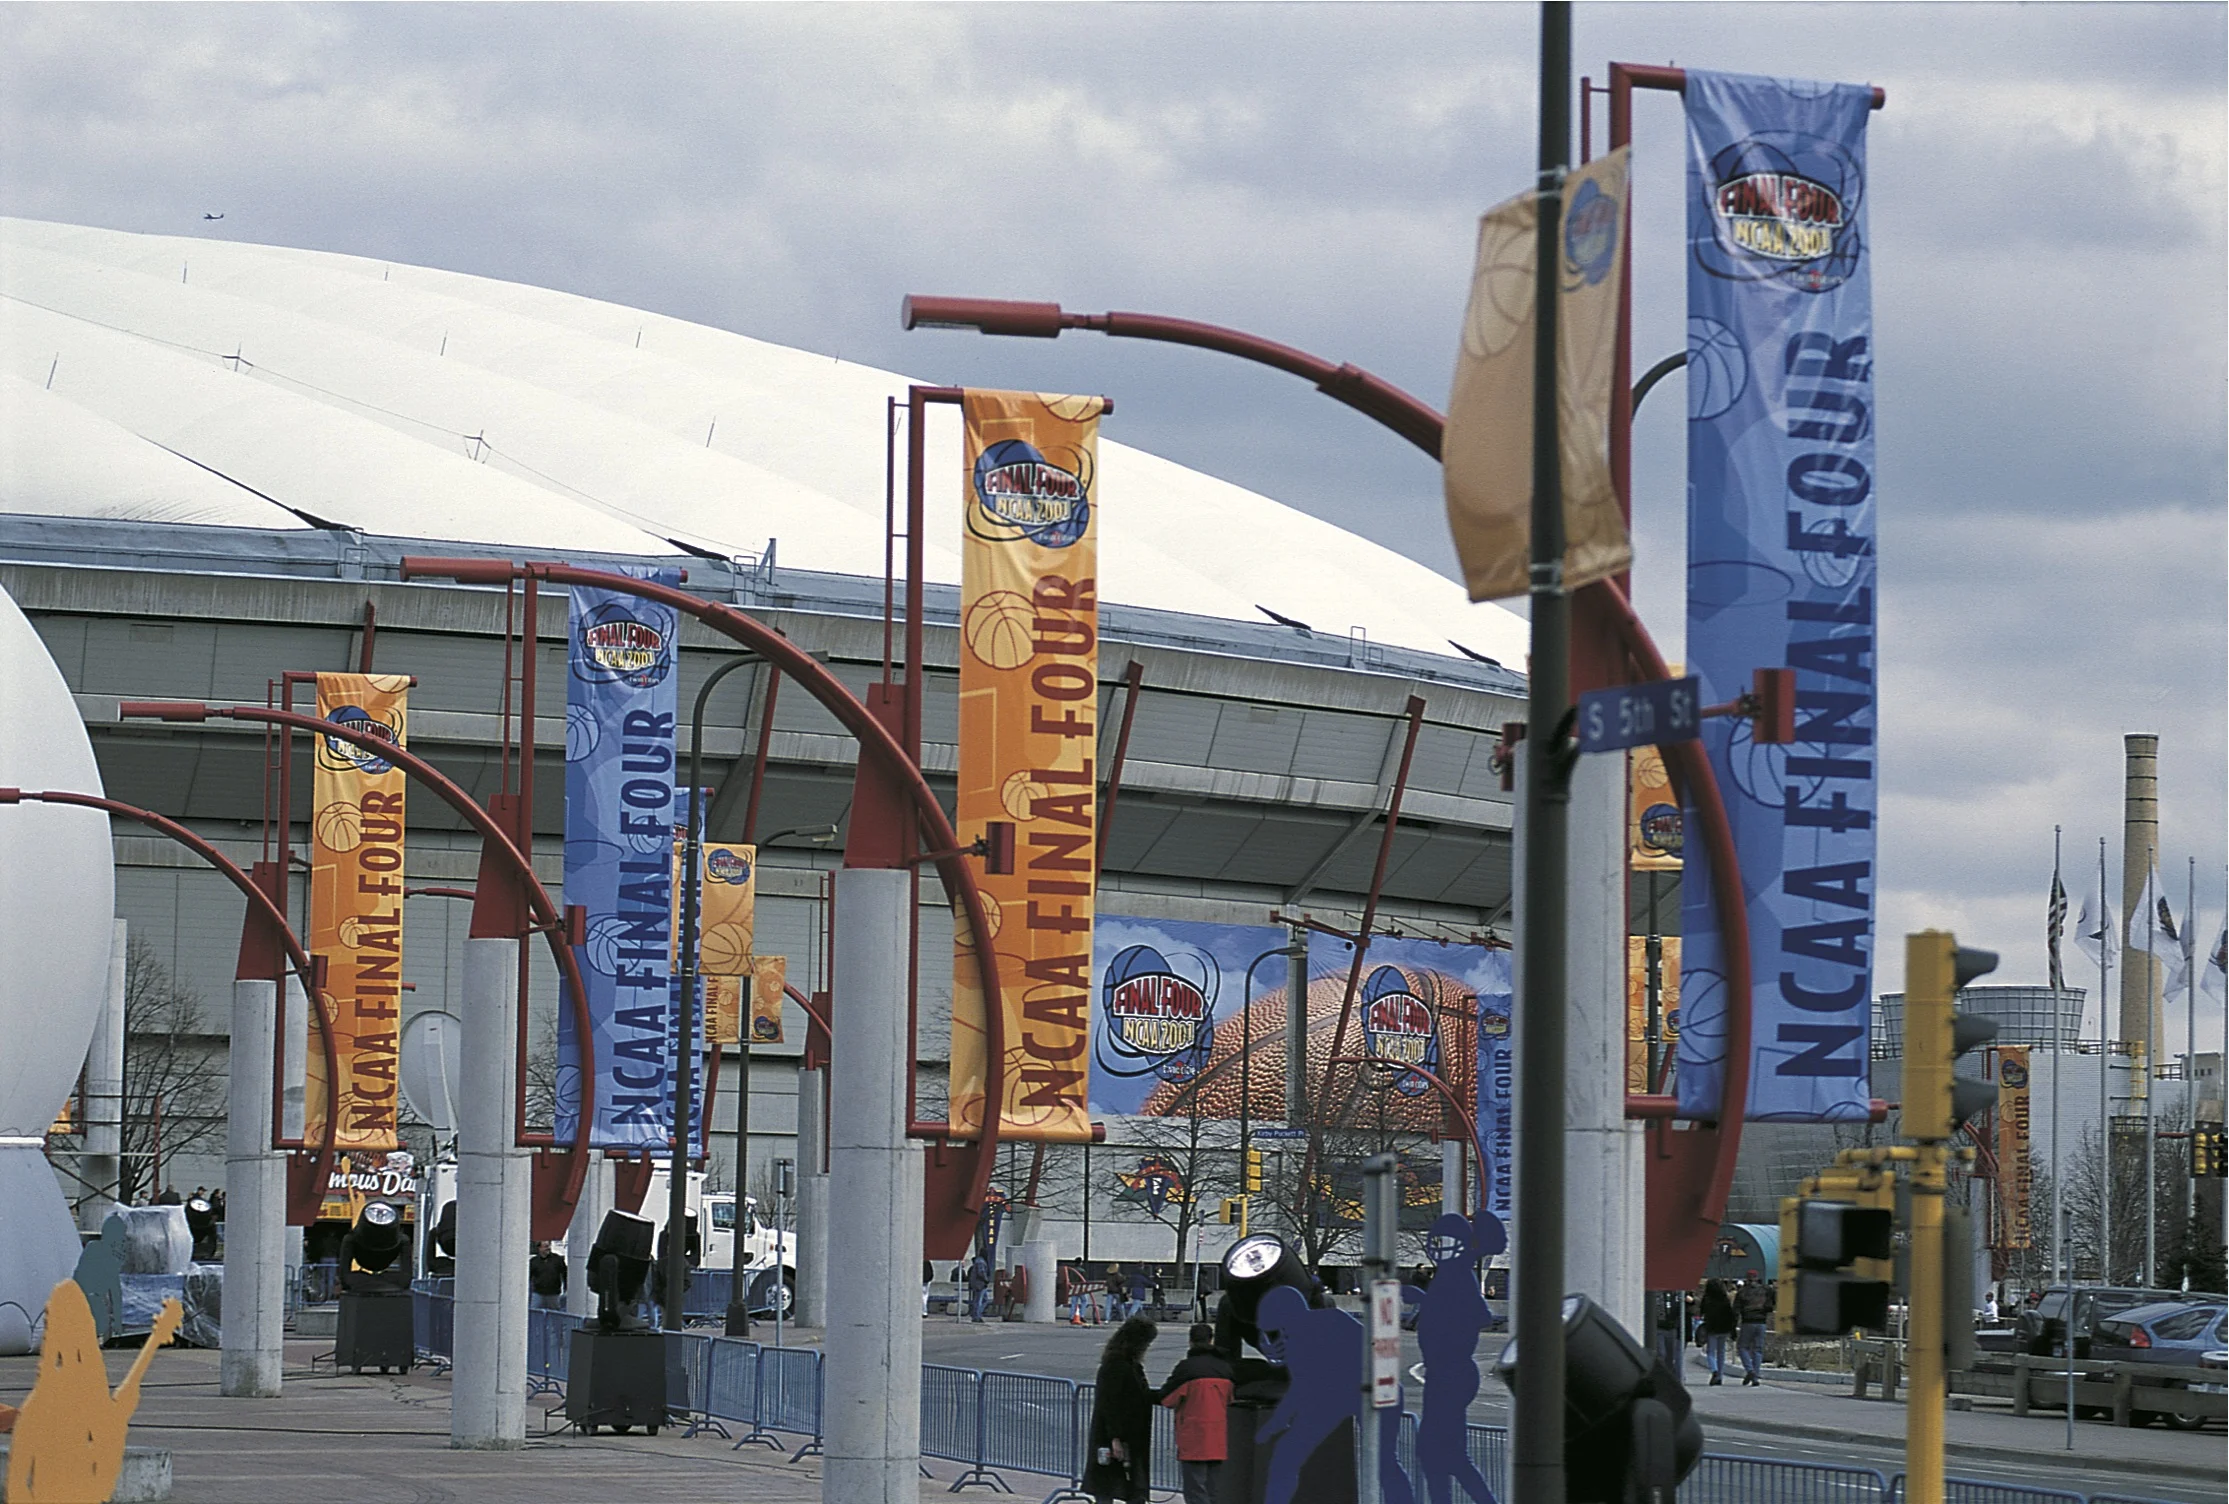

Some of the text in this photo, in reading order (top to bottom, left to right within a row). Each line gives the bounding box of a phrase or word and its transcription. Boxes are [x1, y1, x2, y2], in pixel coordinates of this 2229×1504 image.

[1718, 175, 1842, 225] FINAL FOUR
[1735, 218, 1832, 257] NCAA 2001
[1784, 331, 1872, 559] FOUR
[986, 464, 1079, 499] FINAL FOUR
[996, 497, 1070, 523] NCAA 2001
[587, 623, 661, 650] FINAL FOUR
[595, 648, 654, 669] NCAA 2001
[1030, 575, 1095, 739] FOUR
[1588, 687, 1692, 741] S 5th St
[1783, 586, 1872, 833] FINAL
[358, 790, 403, 896] FOUR
[1026, 758, 1093, 934] FINAL
[610, 709, 674, 1126] NCAA FINAL FOUR
[354, 908, 401, 1020] FINAL
[1775, 860, 1870, 1077] NCAA
[706, 988, 718, 1015] FINAL
[1114, 976, 1202, 1018] FINAL FOUR
[1370, 994, 1432, 1036] FINAL FOUR
[705, 1016, 718, 1043] NCAA
[1019, 953, 1089, 1107] NCAA
[1124, 1020, 1195, 1050] NCAA 2001
[350, 1032, 398, 1131] NCAA
[1494, 1049, 1513, 1099] FOUR
[1495, 1105, 1512, 1158] FINAL
[2014, 1095, 2030, 1142] FOUR
[328, 1171, 379, 1191] mous
[1495, 1163, 1512, 1212] NCAA
[2014, 1145, 2030, 1194] FINAL
